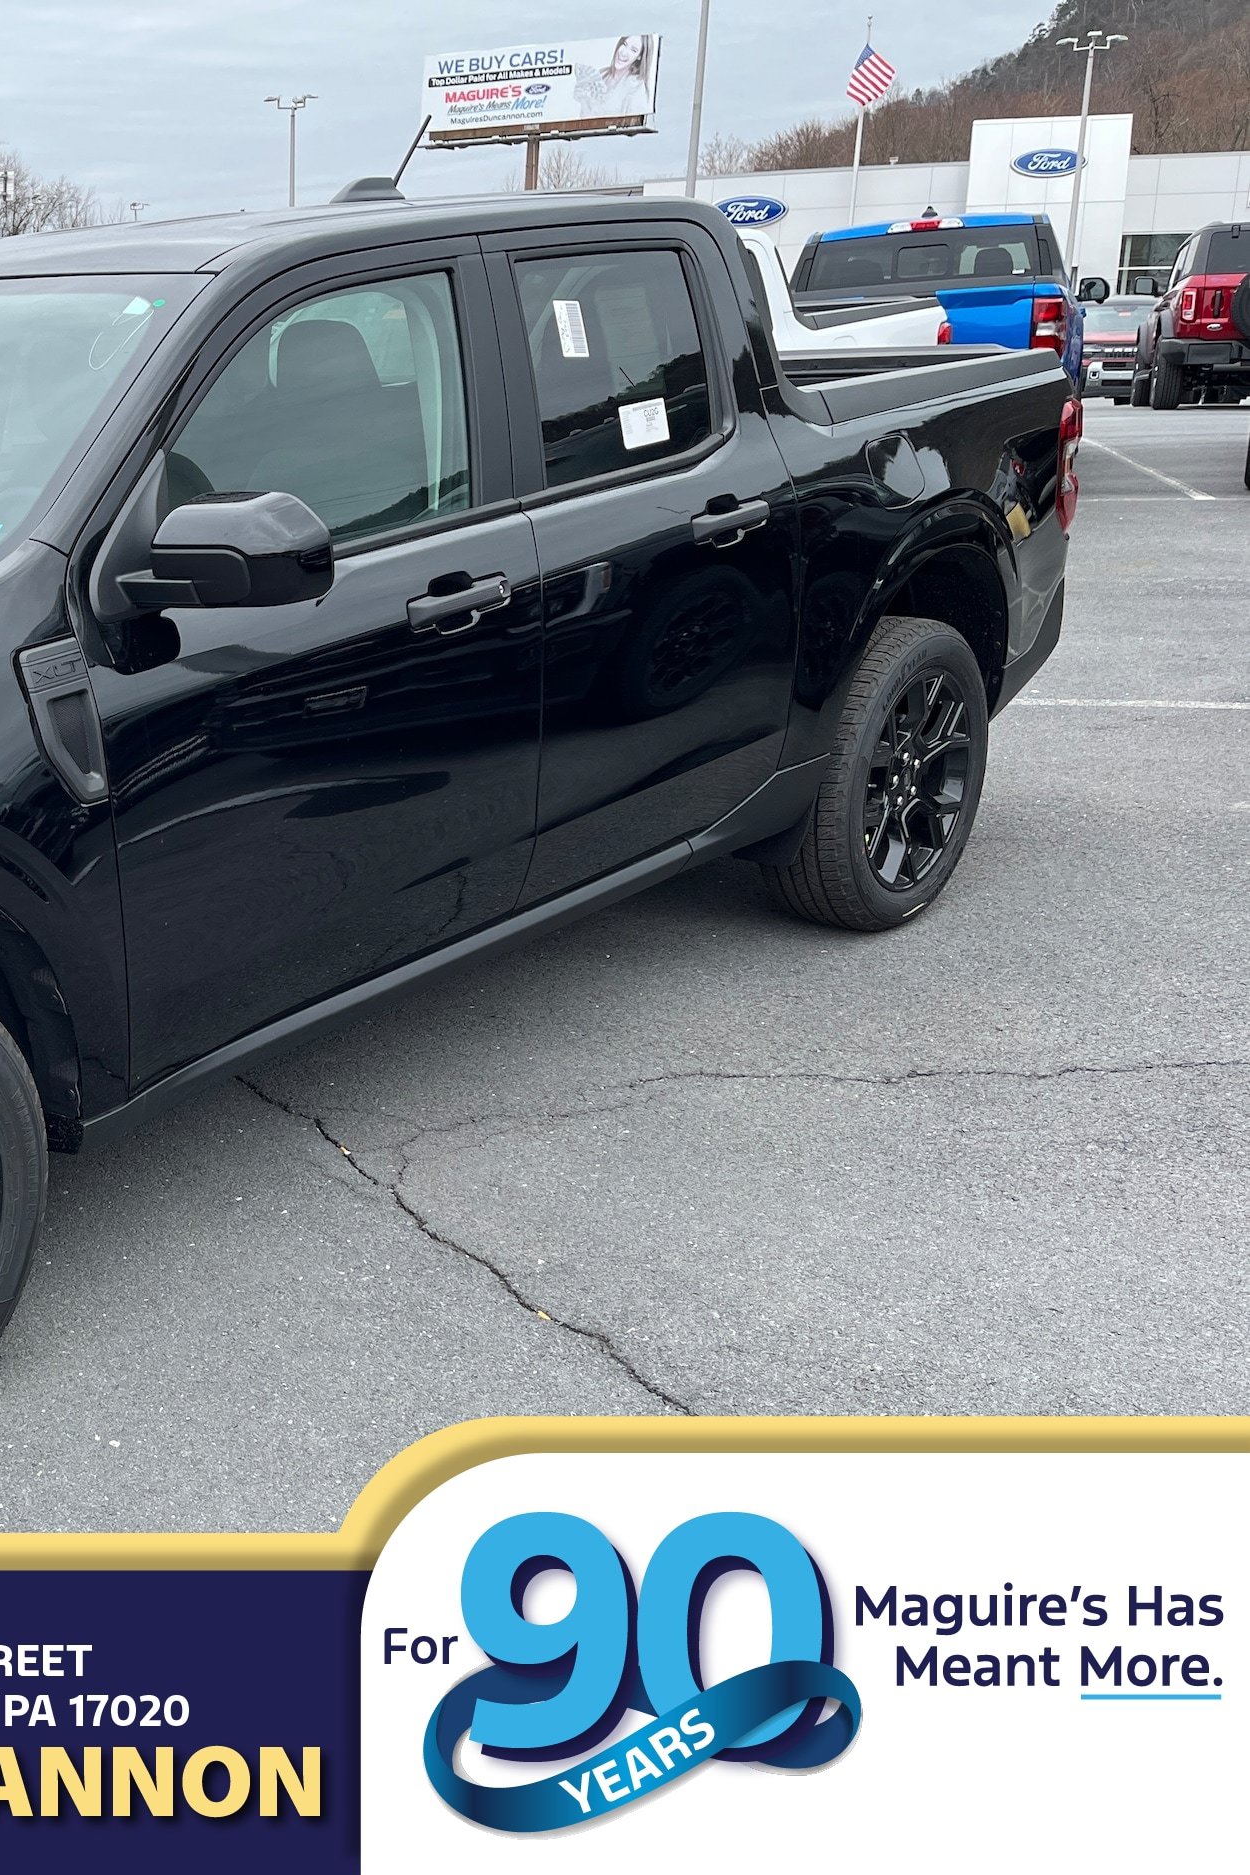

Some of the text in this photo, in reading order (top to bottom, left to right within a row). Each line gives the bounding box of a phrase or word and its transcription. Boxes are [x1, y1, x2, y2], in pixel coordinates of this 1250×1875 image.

[438, 49, 564, 75] WE BUY CARS!
[431, 66, 570, 87] Top Dollar Paid for All Makes & Models
[445, 85, 522, 103] MAGUIRE'S
[447, 95, 547, 114] Maguire's Means More!
[450, 111, 543, 125] MaguiresDuncannon.com
[1026, 154, 1072, 171] Ford
[722, 201, 770, 222] Ford
[32, 657, 81, 684] XLT
